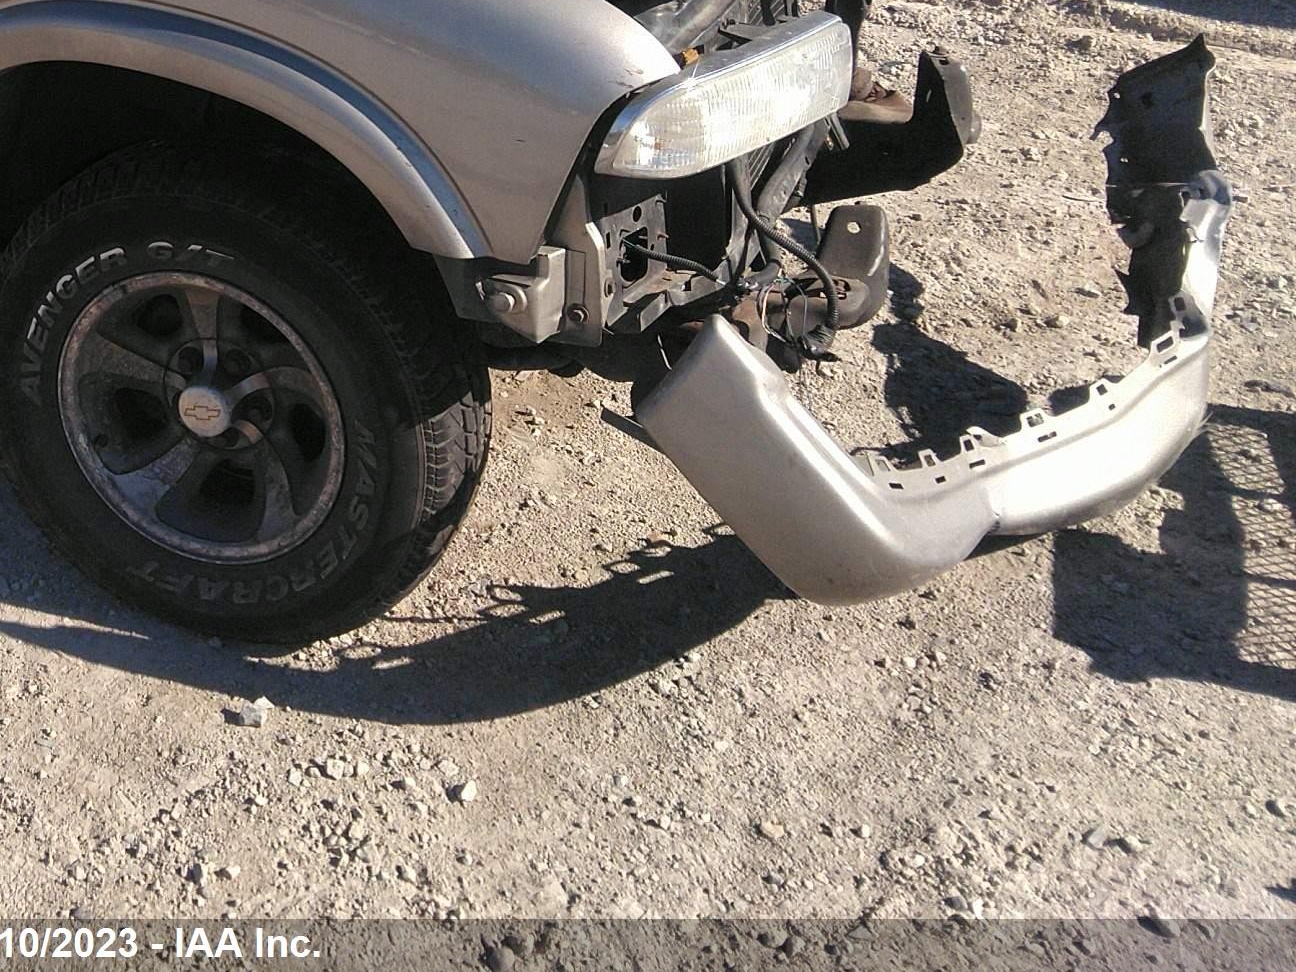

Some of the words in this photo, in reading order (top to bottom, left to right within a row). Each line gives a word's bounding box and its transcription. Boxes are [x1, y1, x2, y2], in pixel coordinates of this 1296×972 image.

[20, 246, 127, 405] AVENGER
[146, 240, 235, 268] G/T
[127, 420, 378, 605] MASTERCRAFT
